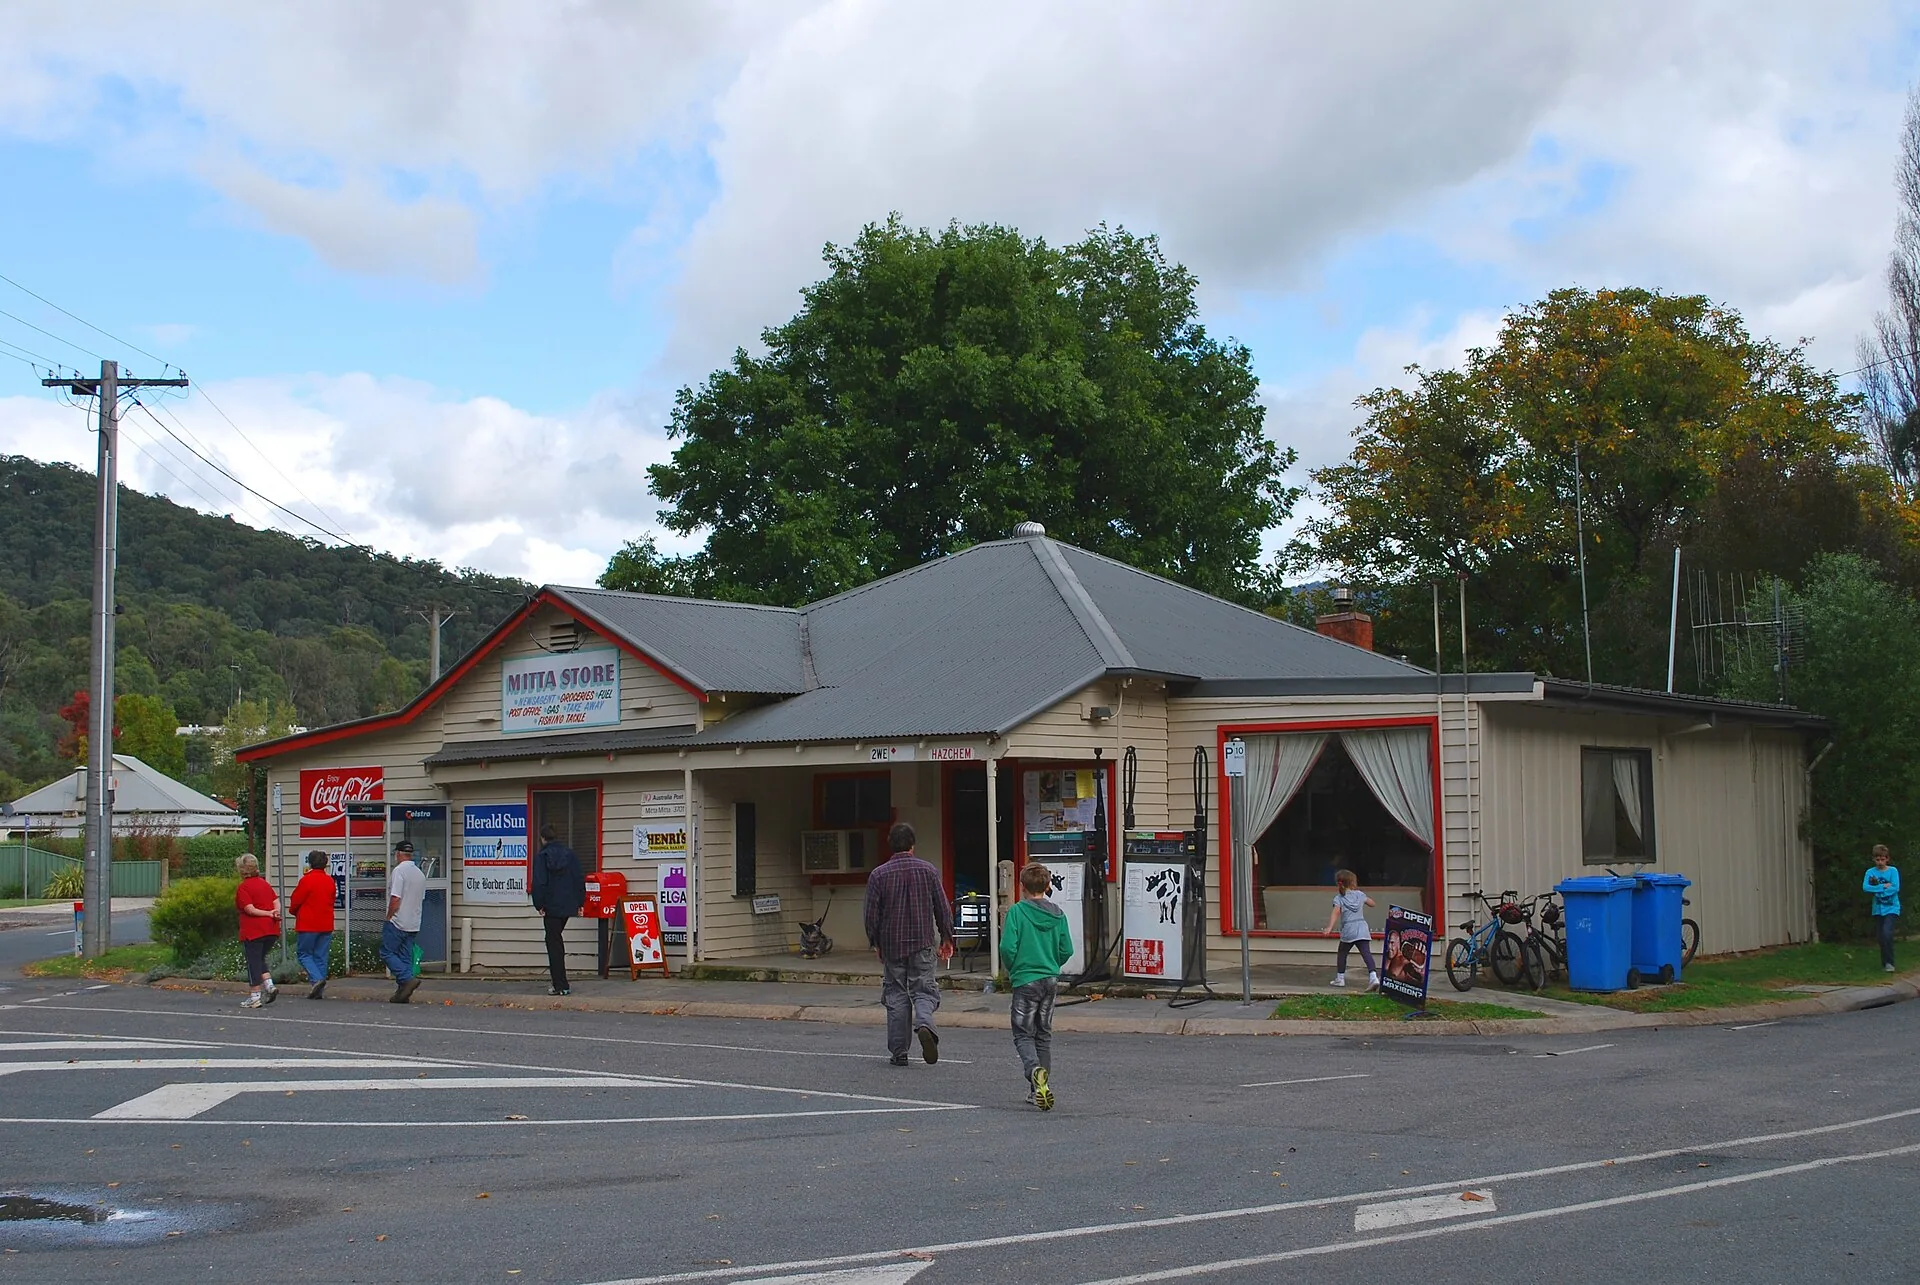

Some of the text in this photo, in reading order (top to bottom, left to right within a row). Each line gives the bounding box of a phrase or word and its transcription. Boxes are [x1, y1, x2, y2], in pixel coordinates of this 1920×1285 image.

[508, 664, 615, 692] MITTA STORE
[518, 689, 613, 706] NEWSAGENT GROCERIES FUEL
[509, 701, 604, 718] POST OFFICE GAS TAKE AWAY
[538, 713, 586, 726] FISHING TACKLE
[871, 748, 888, 760] 2WE
[931, 748, 971, 760] HAZCHEM
[1225, 746, 1243, 759] P 10
[327, 775, 340, 783] Enjoy
[405, 810, 431, 820] Telstra
[466, 813, 526, 830] Herald Sun
[464, 845, 527, 859] WEEKLY TIMES
[1126, 843, 1132, 852] 7
[466, 877, 524, 891] The Border Mail
[660, 891, 687, 904] ELGA
[629, 903, 648, 912] OPEN
[1403, 911, 1431, 926] OPEN
[664, 934, 687, 943] REFILLE
[1383, 980, 1423, 998] MAXIBON?
